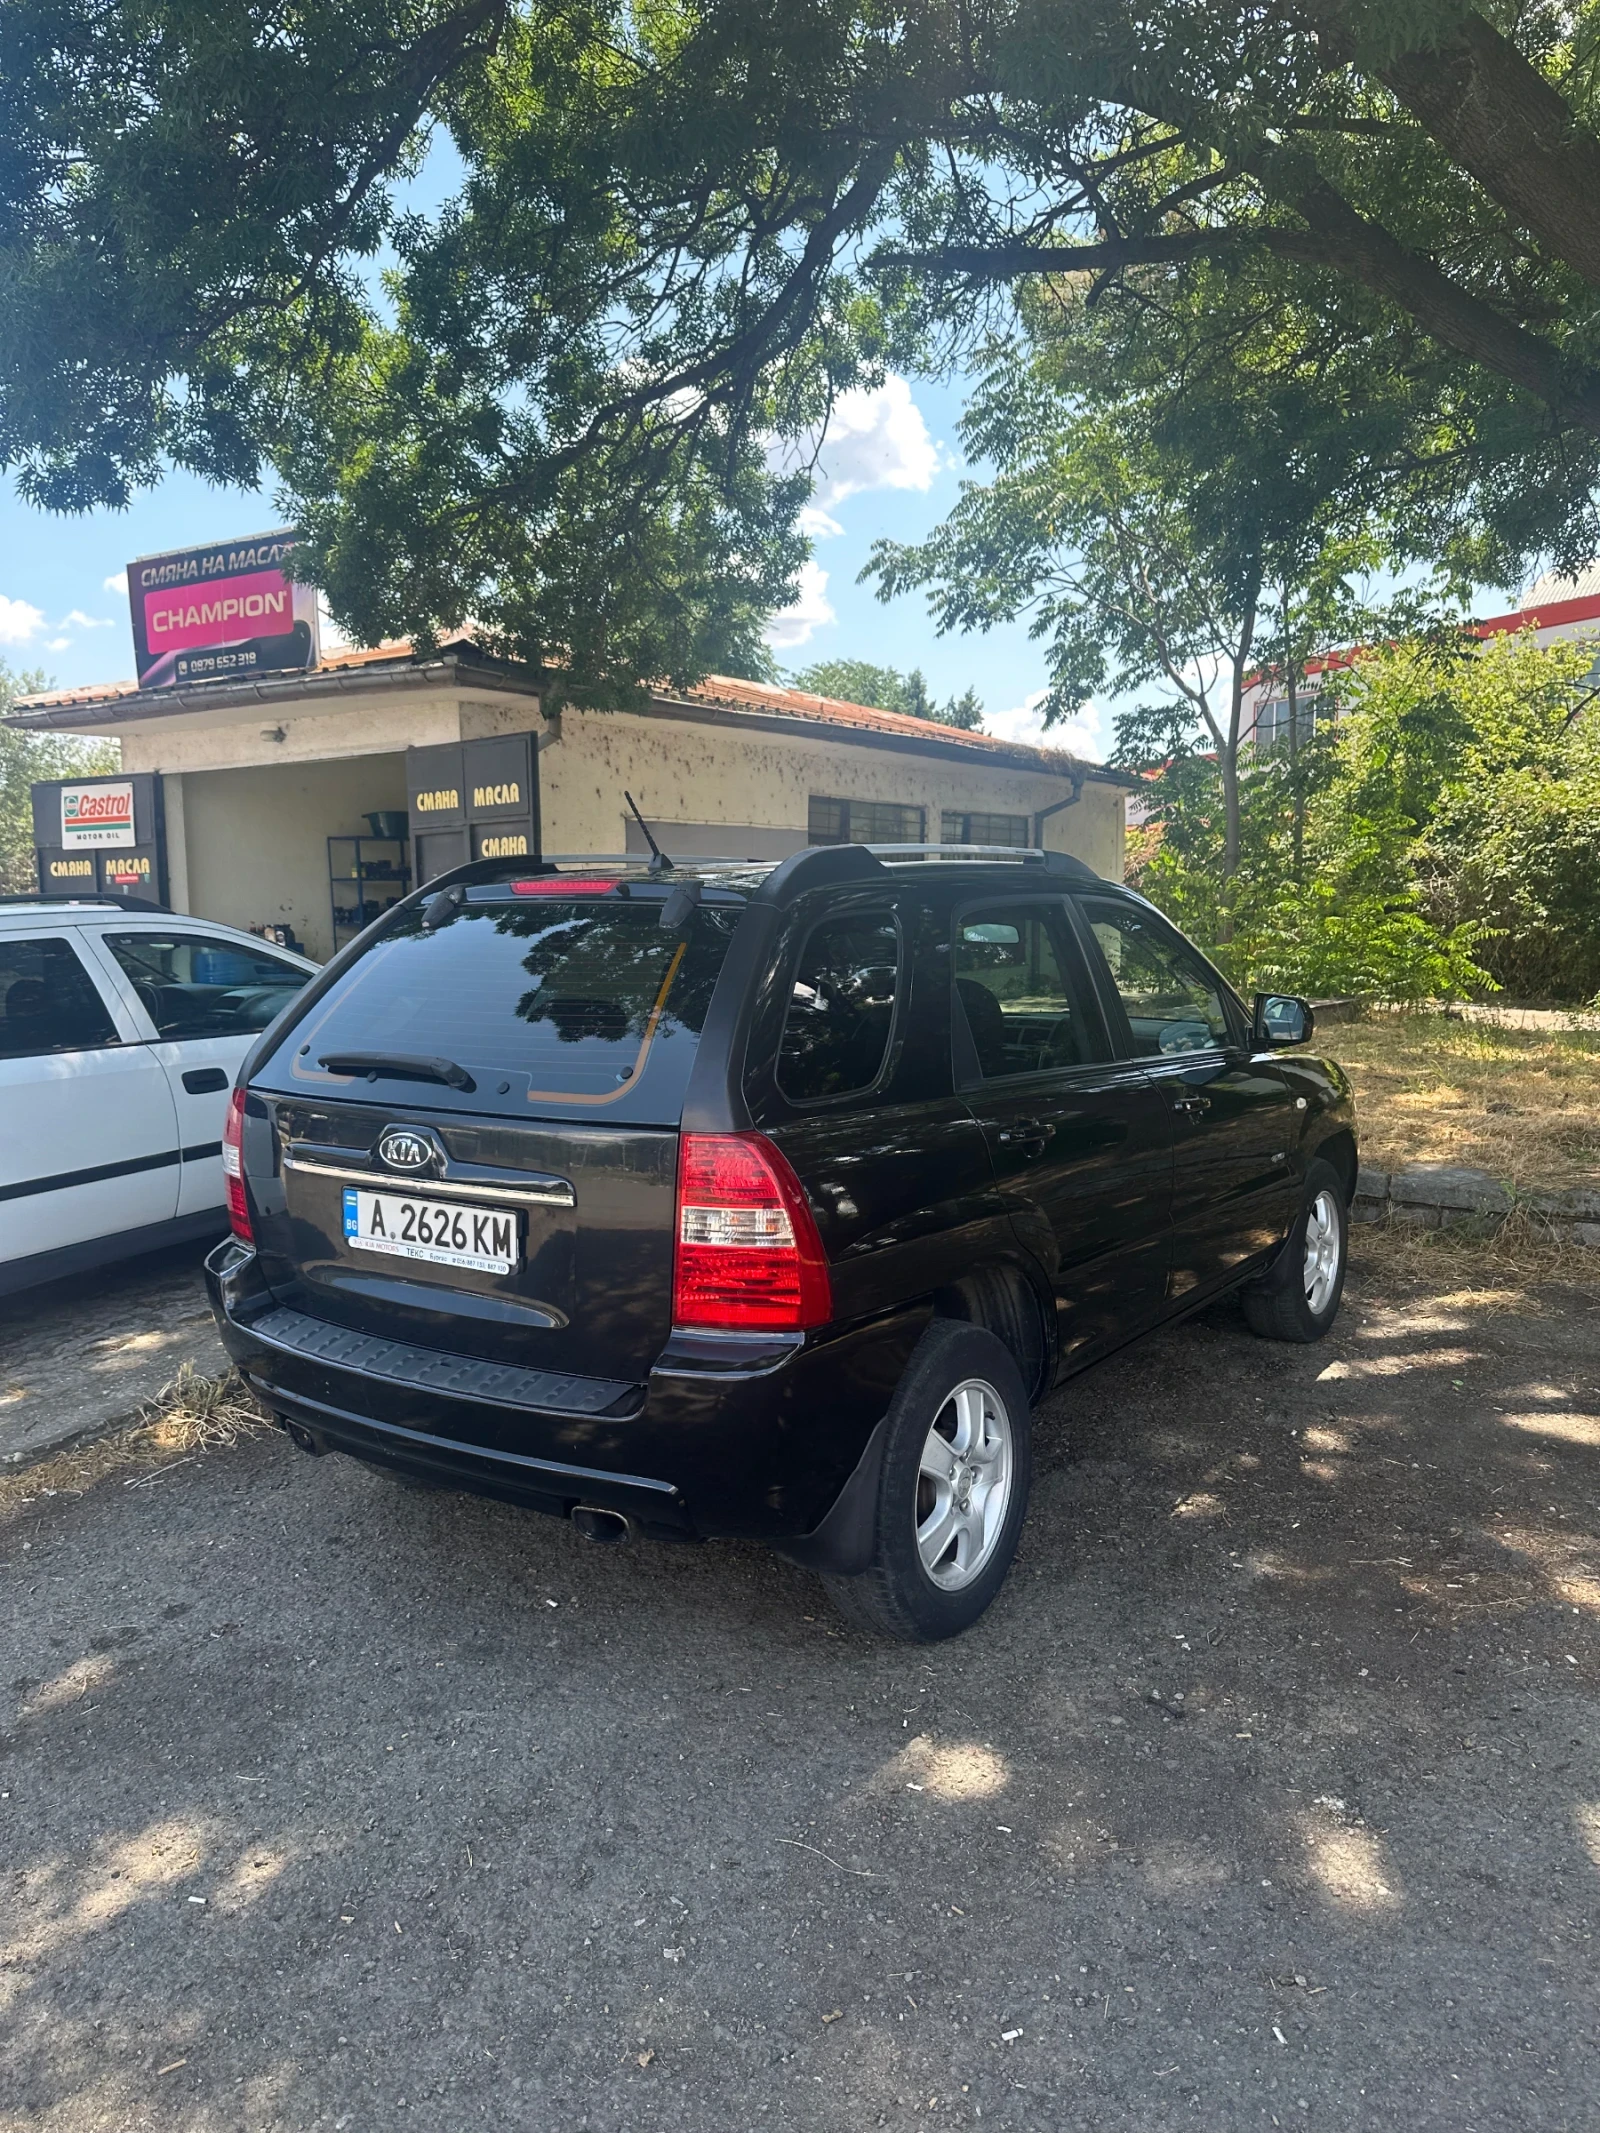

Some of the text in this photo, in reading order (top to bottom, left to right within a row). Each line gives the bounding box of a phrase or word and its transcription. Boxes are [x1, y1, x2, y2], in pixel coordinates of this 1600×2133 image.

[141, 559, 198, 587] СМЯНА
[202, 554, 225, 575] НА
[152, 591, 285, 633] CHAMPION
[216, 654, 237, 669] 652
[79, 793, 130, 817] Castrol
[416, 782, 520, 812] СМЯНА МАСЛА
[481, 835, 528, 857] СМЯНА
[50, 857, 151, 877] СМЯНА МАСЛА
[386, 1138, 421, 1163] KIA
[346, 1219, 358, 1231] BG
[400, 1203, 467, 1250] 2626
